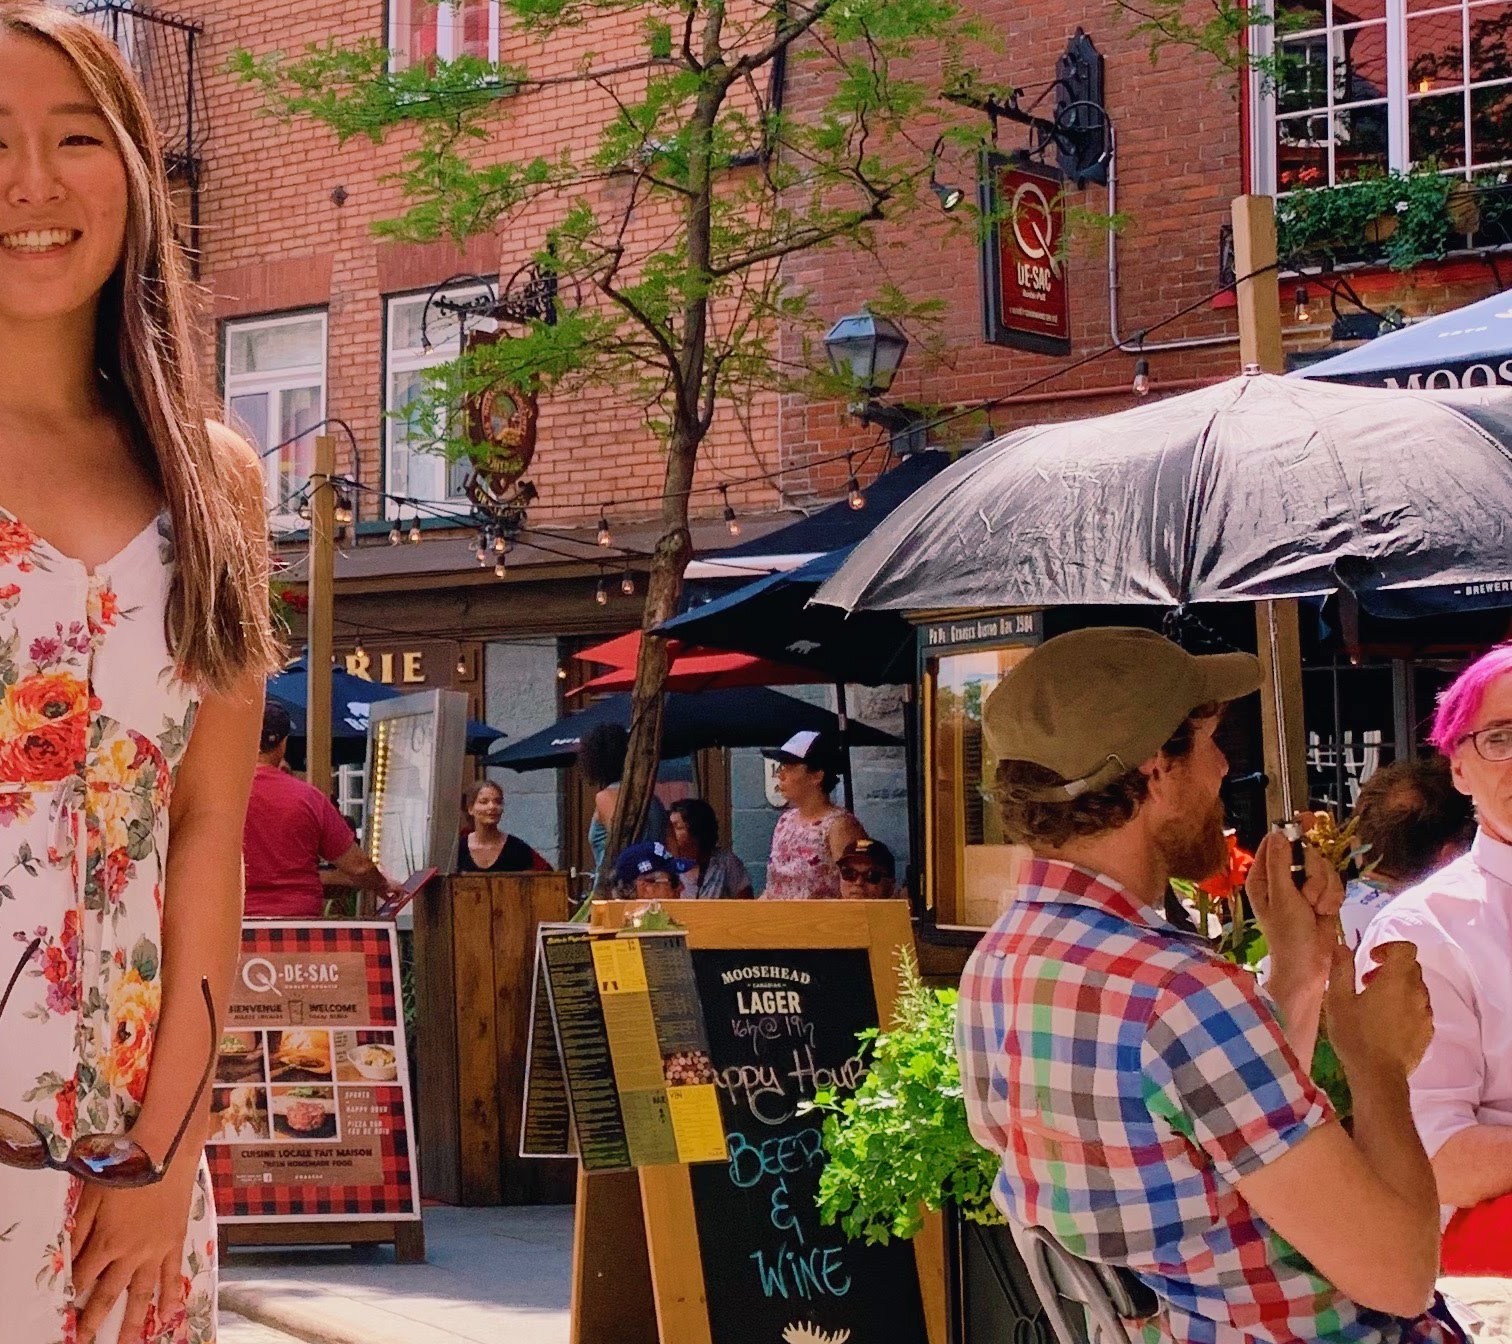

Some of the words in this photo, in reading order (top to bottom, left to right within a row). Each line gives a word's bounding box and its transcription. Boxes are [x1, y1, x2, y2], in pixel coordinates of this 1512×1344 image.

[345, 651, 426, 684] RIE
[721, 965, 811, 985] MOOSEHEAD
[308, 1003, 357, 1013] WELCOME
[736, 991, 802, 1015] LAGER
[279, 1149, 311, 1158] LOCALE
[314, 1148, 333, 1157] FAIT
[338, 1148, 372, 1157] MAISON
